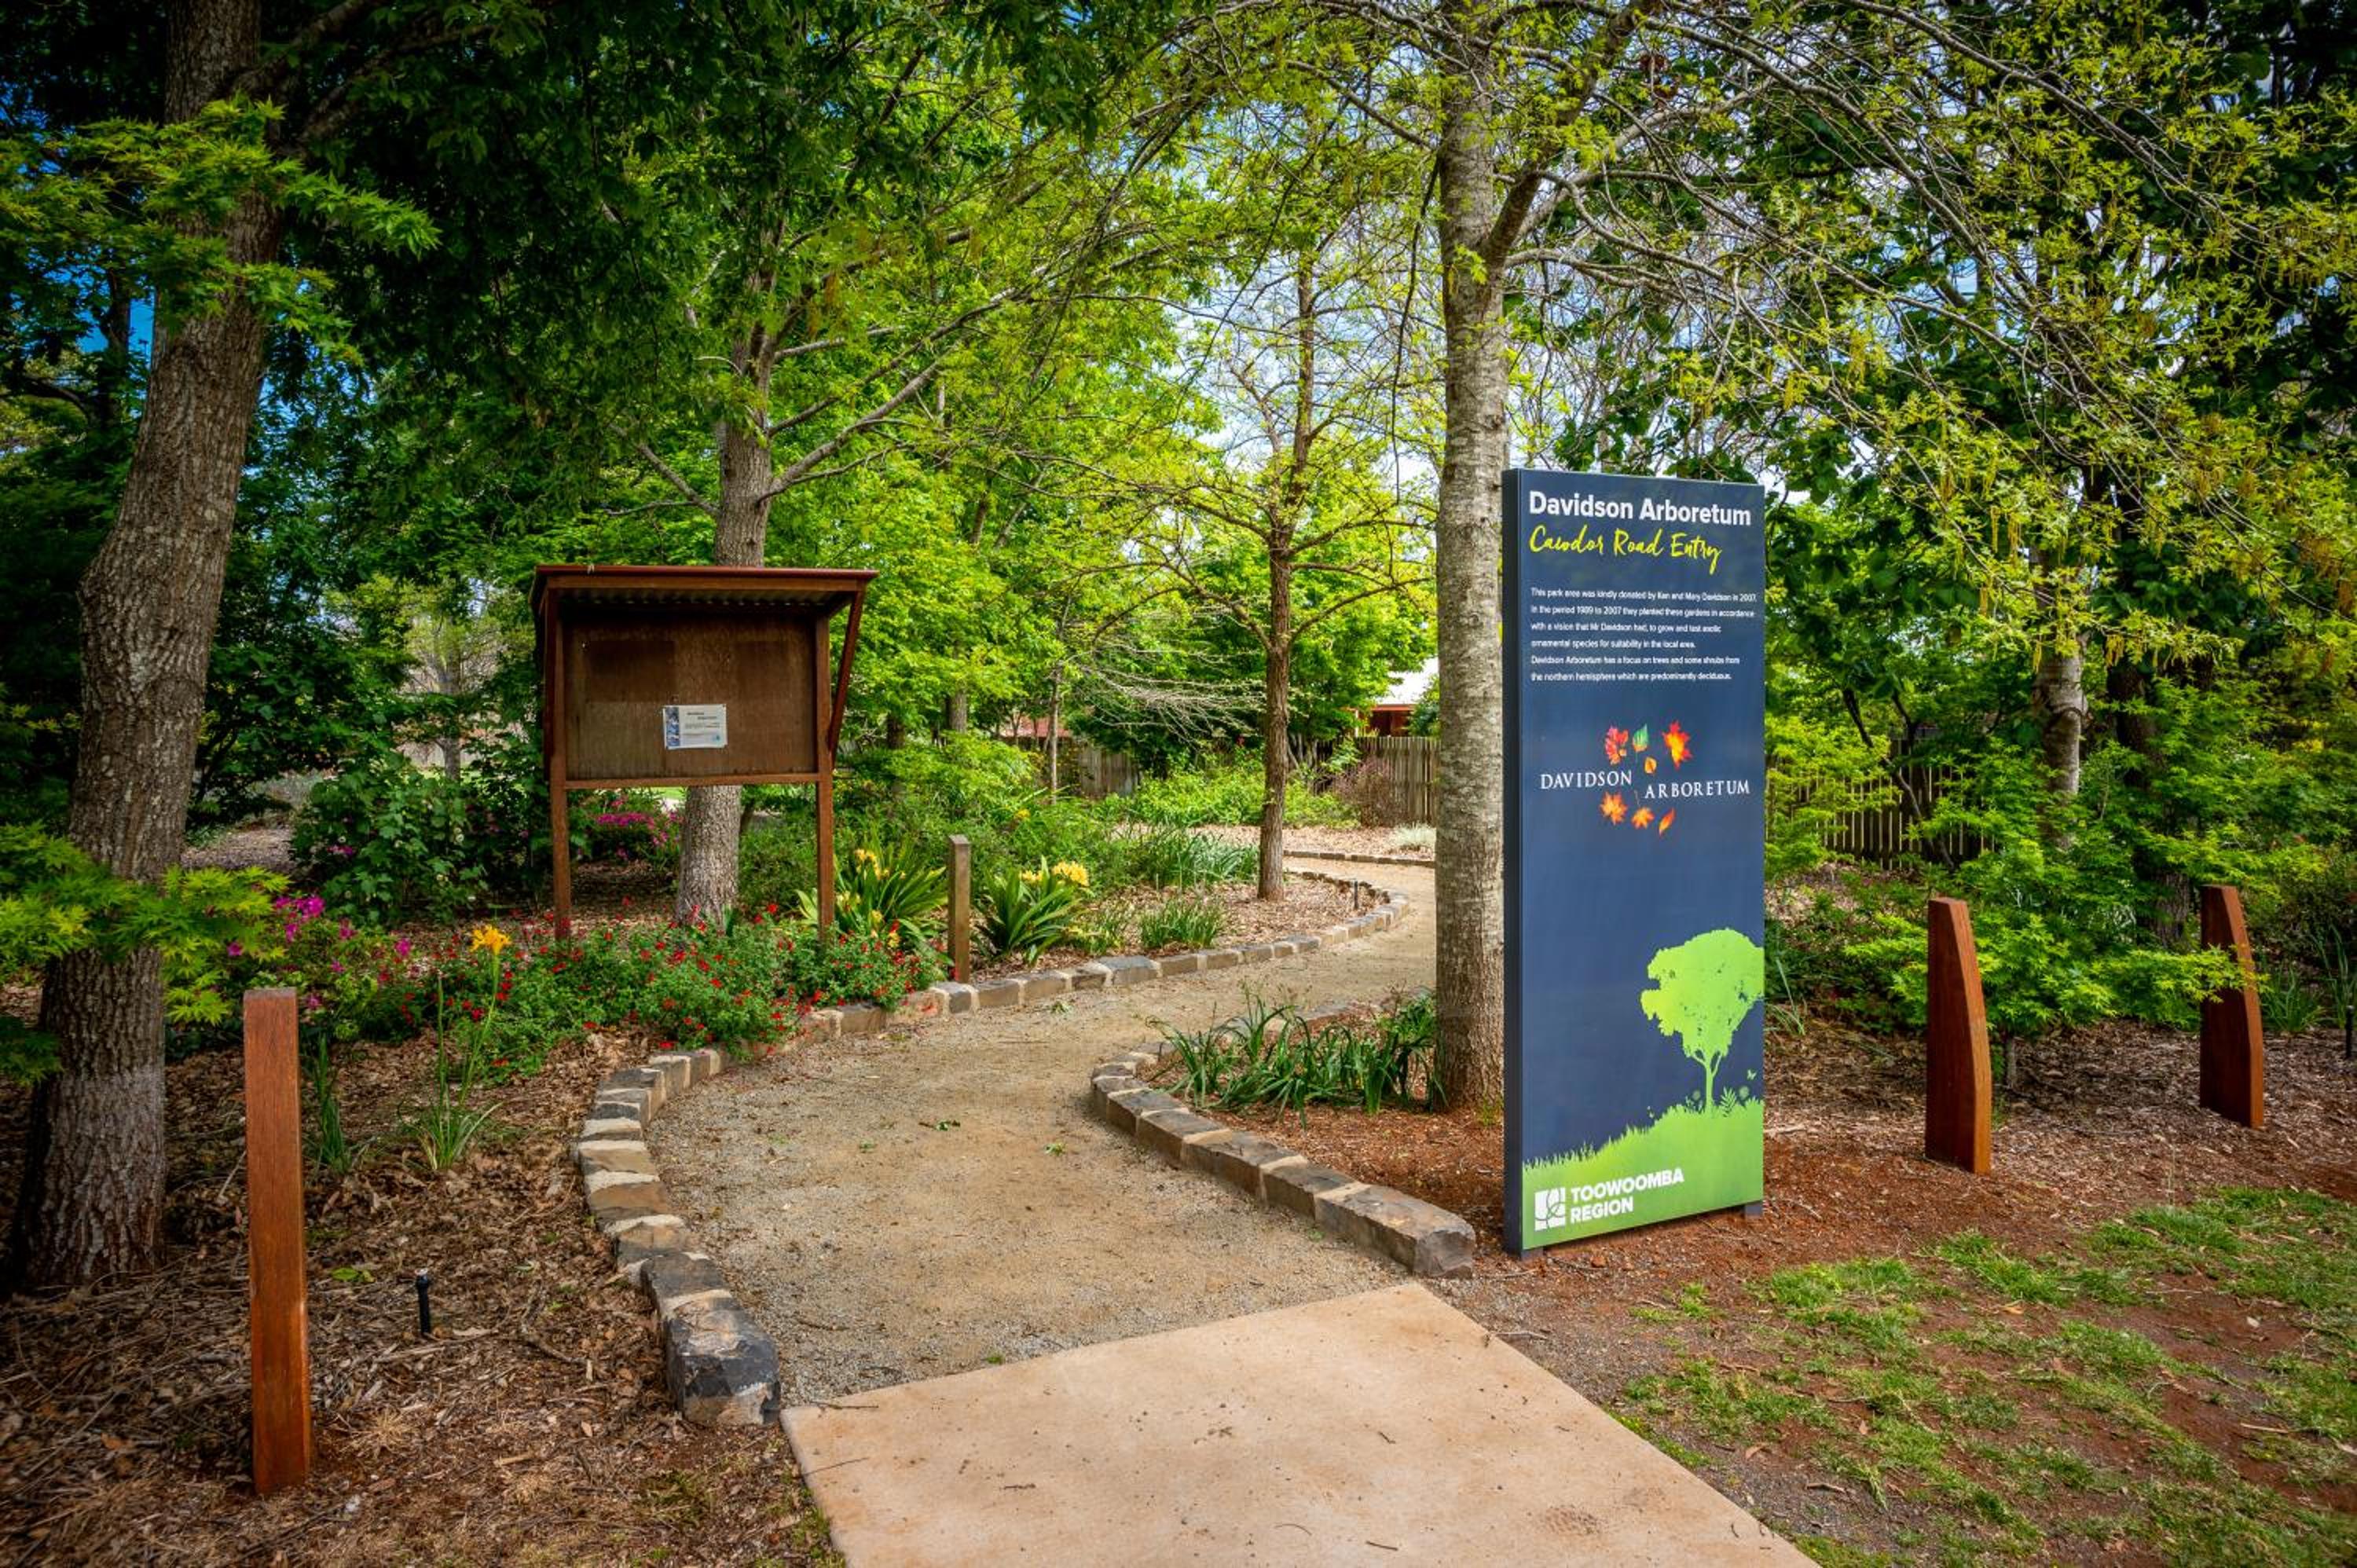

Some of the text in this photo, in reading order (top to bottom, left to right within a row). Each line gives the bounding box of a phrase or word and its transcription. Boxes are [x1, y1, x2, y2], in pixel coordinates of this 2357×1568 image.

[1529, 490, 1752, 526] Davidson Arboretum
[1612, 527, 1664, 557] Road
[1670, 532, 1723, 575] Entry
[1531, 587, 1546, 598] This
[1547, 588, 1563, 599] park
[1597, 590, 1618, 600] kindly
[1618, 590, 1647, 599] donated
[1648, 591, 1657, 601] by
[1685, 592, 1701, 603] Mary
[1702, 592, 1732, 601] Davidson
[1552, 606, 1575, 615] period
[1604, 606, 1622, 614] 2007
[1622, 606, 1637, 616] they
[1639, 606, 1664, 617] planted
[1665, 607, 1683, 616] these
[1684, 608, 1710, 618] gardens
[1531, 621, 1546, 630] with
[1554, 622, 1574, 631] vision
[1575, 622, 1589, 631] that
[1658, 625, 1674, 634] grow
[1572, 639, 1599, 649] species
[1600, 639, 1610, 648] for
[1611, 639, 1643, 650] suitability
[1651, 639, 1662, 648] the
[1531, 655, 1564, 664] Davidson
[1725, 656, 1740, 665] from
[1531, 672, 1543, 681] the
[1544, 672, 1574, 681] northern
[1575, 672, 1616, 683] hemisphere
[1617, 672, 1637, 681] which
[1651, 672, 1697, 683] predominantly
[1540, 769, 1750, 800] DAVIDSON ARBORETUM
[1571, 1167, 1684, 1203] TOOWOOMBA
[1571, 1196, 1634, 1225] REGION
